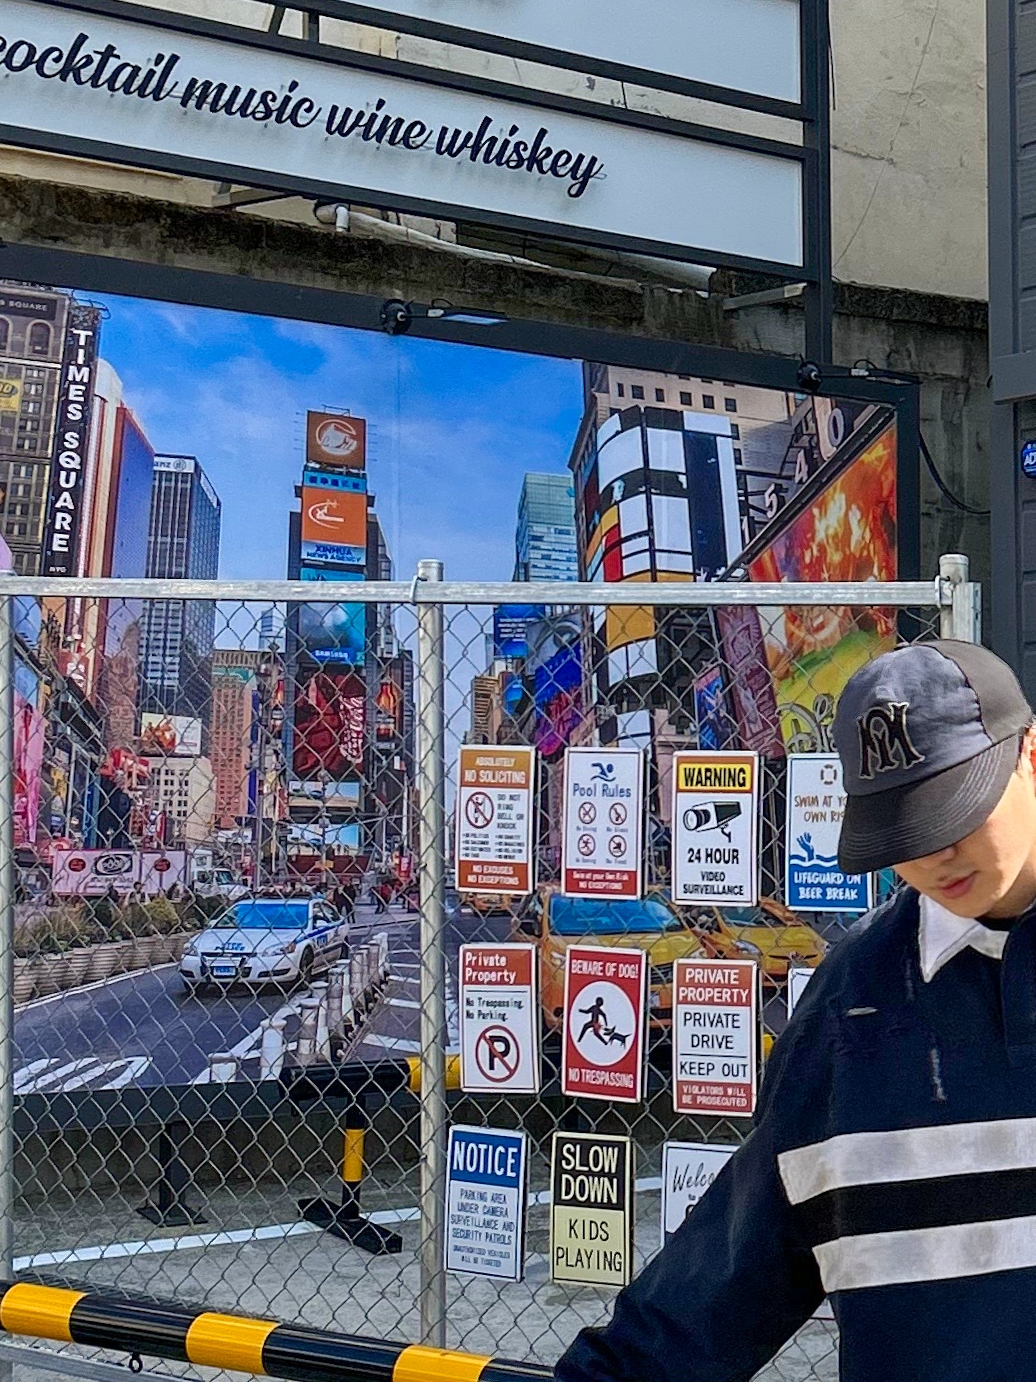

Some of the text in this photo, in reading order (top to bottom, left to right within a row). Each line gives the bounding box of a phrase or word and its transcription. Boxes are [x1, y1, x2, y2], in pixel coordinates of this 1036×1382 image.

[179, 79, 323, 128] music
[325, 98, 434, 150] wine
[434, 116, 604, 198] whiskey
[51, 328, 93, 552] TIMES SQUARE
[465, 770, 526, 784] NO SOLICITING
[684, 767, 746, 788] WARNING
[573, 783, 632, 798] Pool Rules
[794, 795, 820, 808] SWIM
[822, 795, 834, 808] AT
[804, 811, 827, 822] OWN
[688, 848, 740, 864] 24 HOUR
[700, 871, 726, 882] VIDEO
[794, 872, 862, 885] LIFEGUARD ON
[683, 884, 744, 896] SURVEILLANCE
[798, 888, 858, 900] BEER BREAK
[466, 952, 507, 967] Private
[466, 968, 516, 984] Property
[571, 960, 639, 978] BEWARE OF DOG!
[685, 968, 740, 984] PRIVATE
[466, 998, 474, 1006] No
[678, 986, 750, 1004] PROPERTY
[466, 1010, 474, 1019] No
[684, 1012, 740, 1028] PRIVATE
[691, 1034, 734, 1050] DRIVE
[680, 1061, 748, 1078] KEEP OUT
[569, 1068, 634, 1088] NO TRESPASSING
[682, 1085, 746, 1096] VIOLATORS WILL
[682, 1094, 747, 1107] BE PROSECUTED
[453, 1140, 518, 1178] NOTICE
[562, 1143, 618, 1174] SLOW
[672, 1162, 716, 1193] Welco
[460, 1188, 507, 1204] PARKING AREA
[561, 1174, 618, 1204] DOWN
[457, 1202, 509, 1218] UNDER CAMERA
[450, 1214, 515, 1232] SURVEILLANCE AND
[568, 1218, 610, 1242] KIDS
[452, 1228, 512, 1246] SECURITY PATROLS
[556, 1246, 622, 1272] PLAYING
